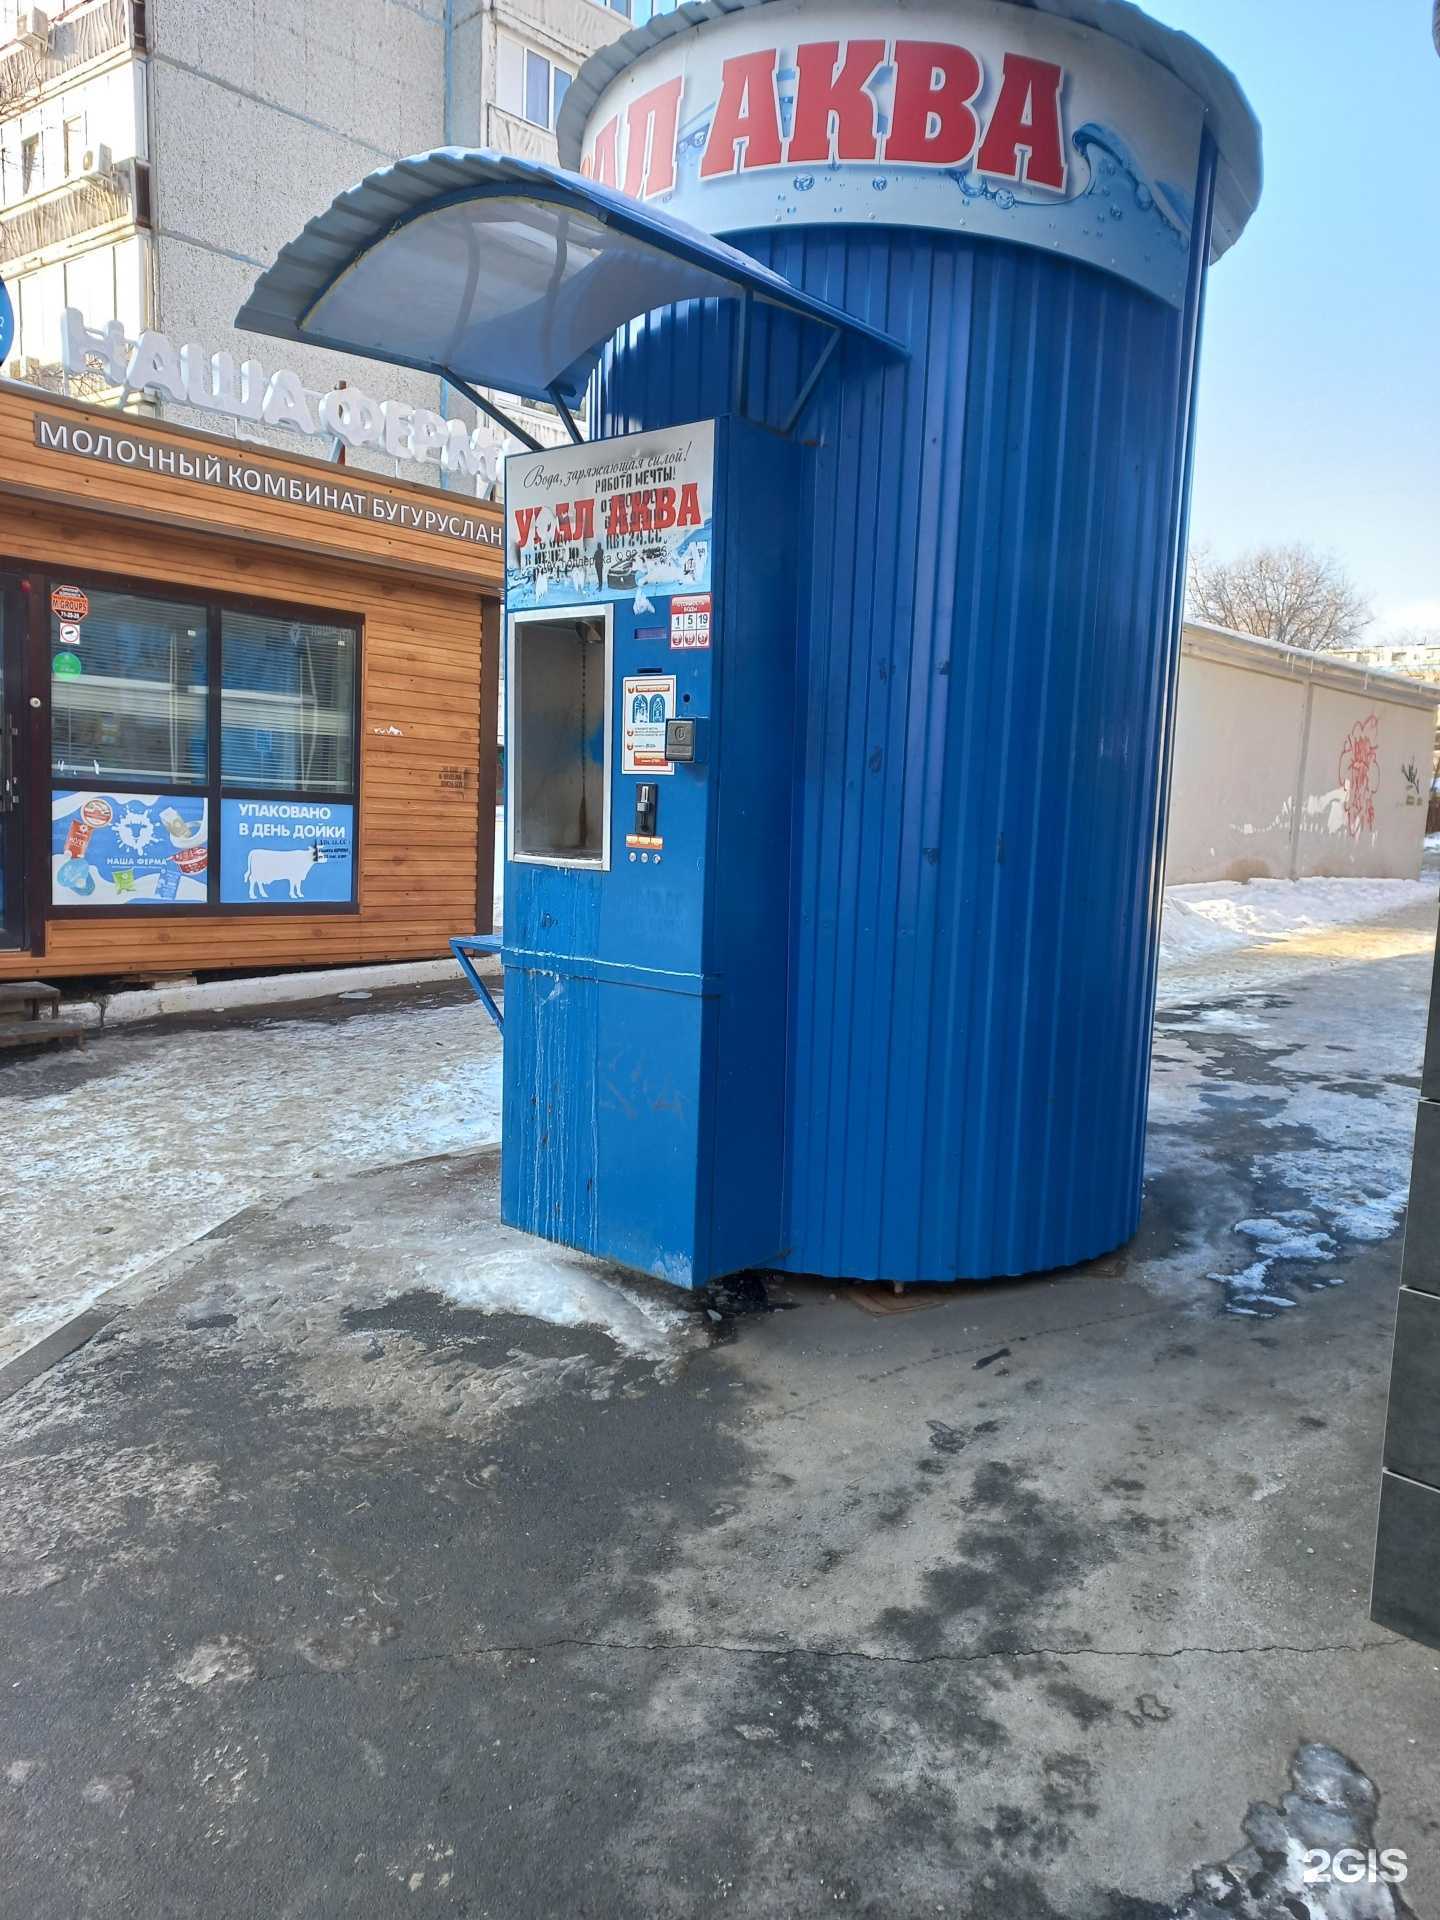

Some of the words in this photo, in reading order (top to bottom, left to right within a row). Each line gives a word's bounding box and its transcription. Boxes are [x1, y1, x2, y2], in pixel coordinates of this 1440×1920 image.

[580, 75, 684, 199] АЛ
[698, 38, 1067, 194] АКВА
[61, 307, 317, 434] НАША
[40, 420, 222, 484] МОЛОЧНЫЙ
[228, 465, 366, 515] КОМБИНАТ
[373, 498, 502, 545] БУГУРУСЛАН
[523, 464, 563, 489] Вода,
[562, 457, 644, 488] заряжающая
[647, 441, 692, 467] силой!
[595, 472, 632, 493] РАБОТА
[635, 466, 676, 485] МЕЧТЫ!
[514, 498, 595, 548] УАЛ
[606, 482, 702, 535] АКВА
[687, 614, 694, 625] 5
[698, 614, 709, 624] 19
[238, 803, 332, 820] УПАКОВАНО
[239, 822, 249, 836] В
[251, 823, 290, 838] ДЕНЬ
[292, 822, 346, 839] ДОЙКИ
[106, 857, 134, 865] НАША
[136, 857, 167, 866] ФЕРМА
